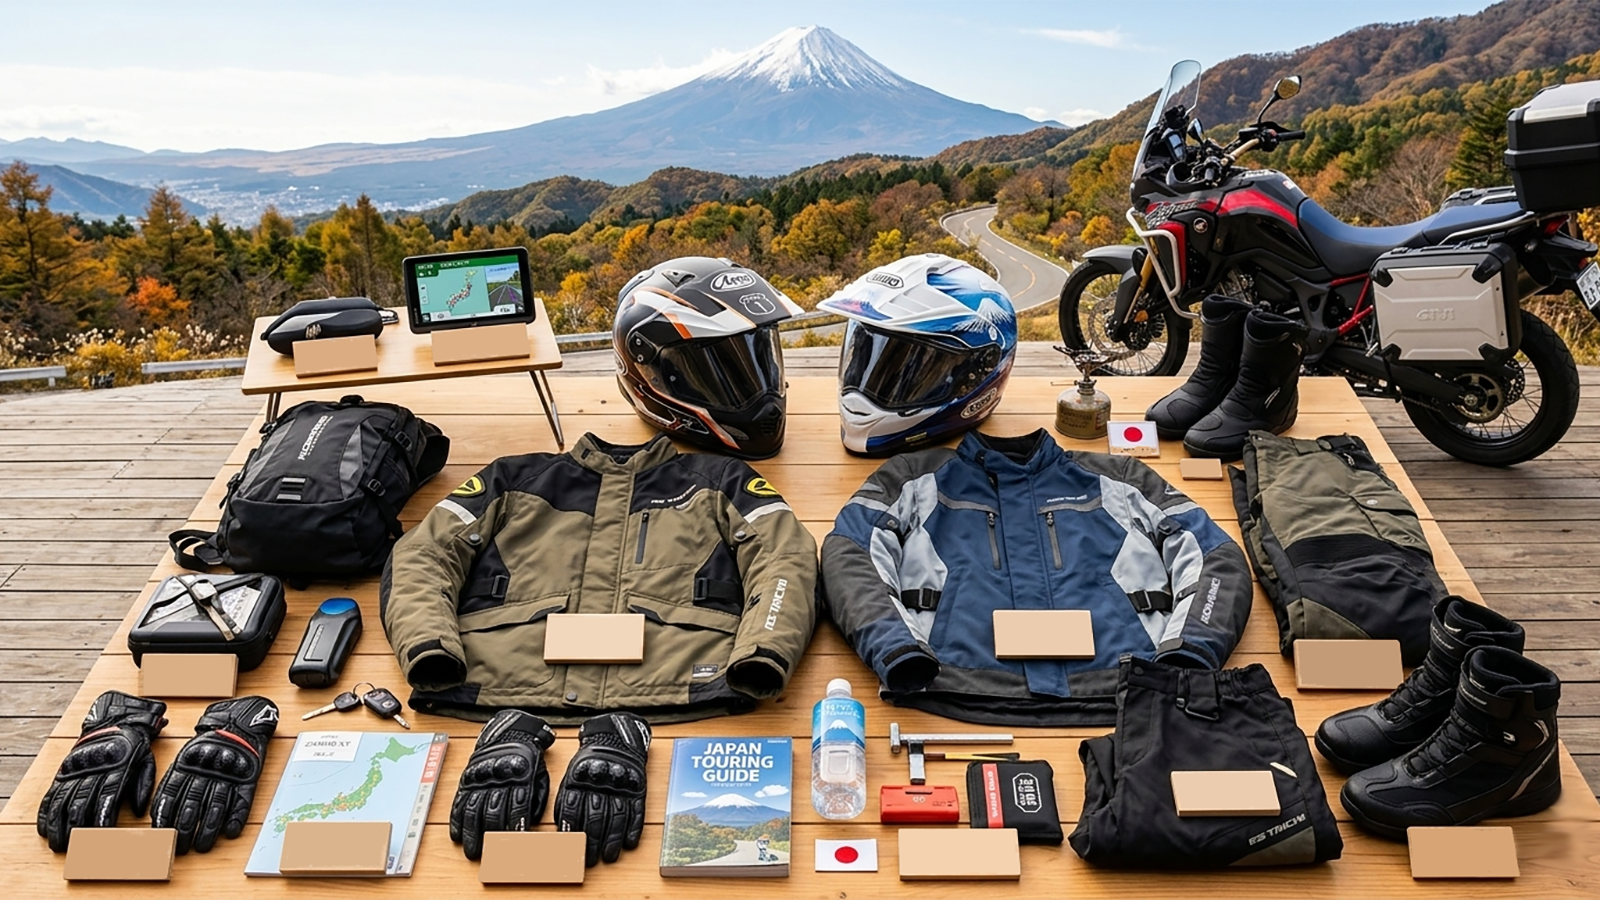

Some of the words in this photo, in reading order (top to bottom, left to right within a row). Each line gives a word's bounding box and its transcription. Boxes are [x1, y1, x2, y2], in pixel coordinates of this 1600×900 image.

[703, 742, 762, 755] JAPAN
[691, 755, 774, 769] TOURING
[702, 769, 760, 782] GUIDE
